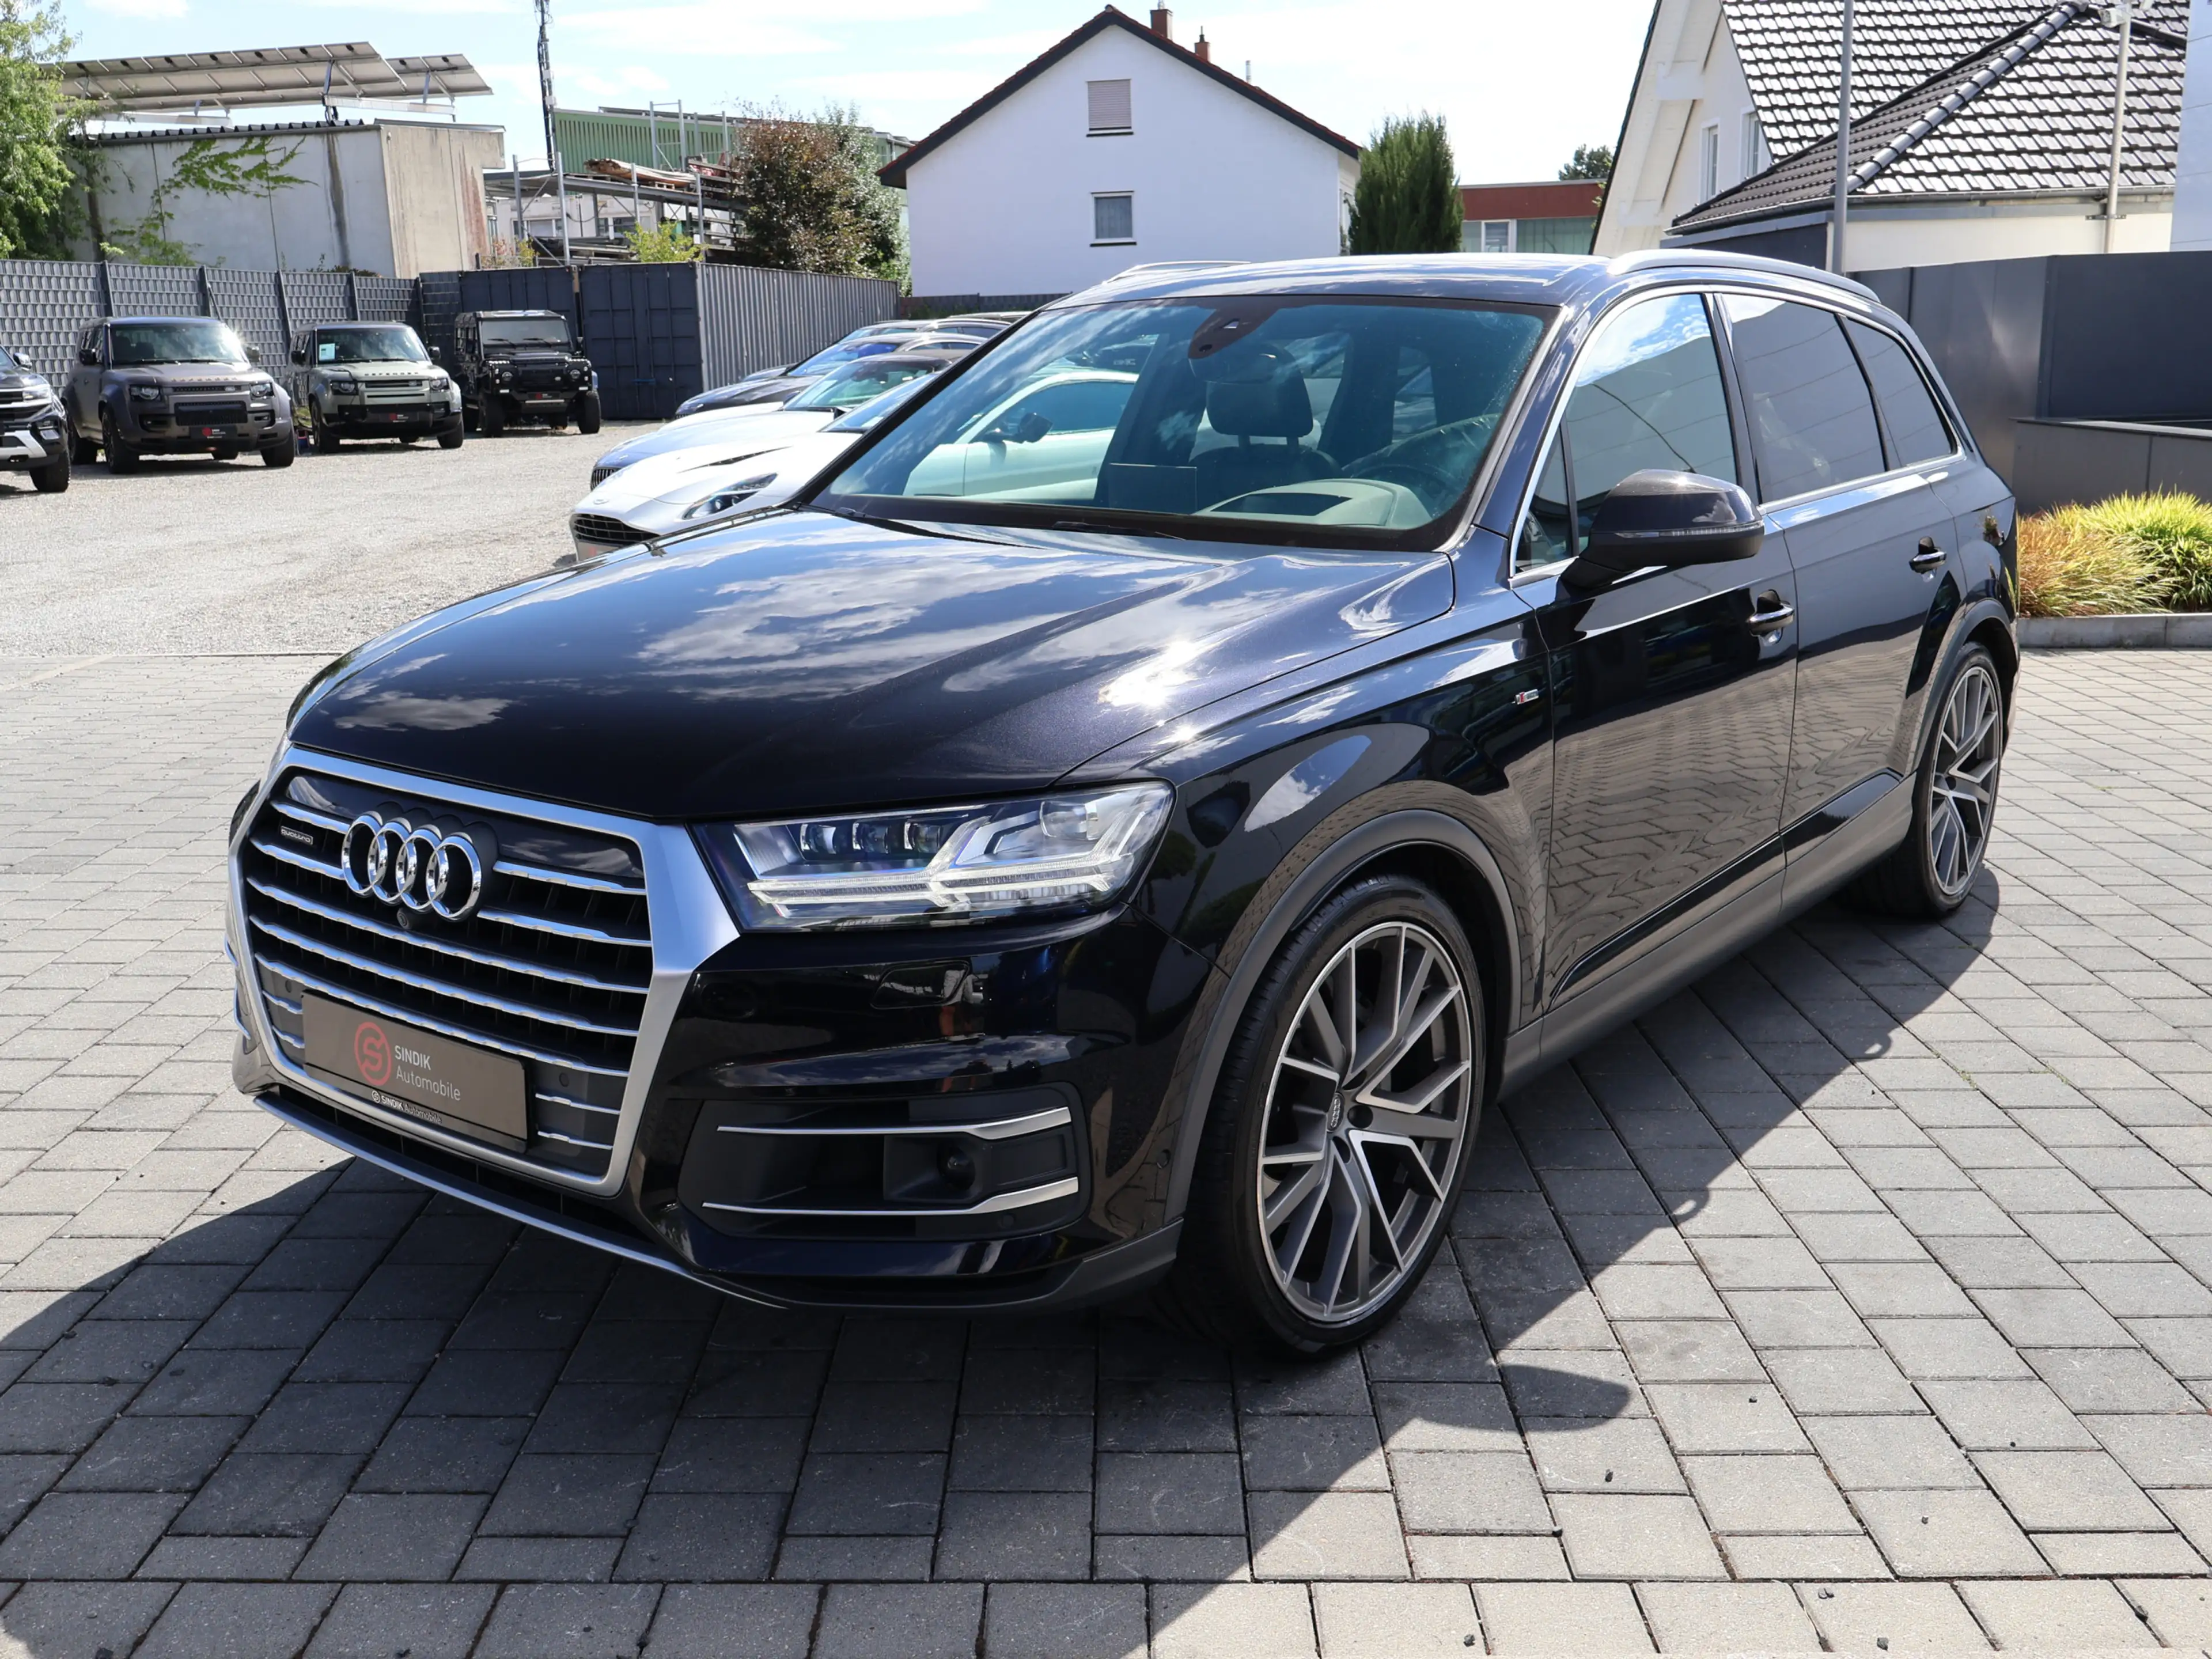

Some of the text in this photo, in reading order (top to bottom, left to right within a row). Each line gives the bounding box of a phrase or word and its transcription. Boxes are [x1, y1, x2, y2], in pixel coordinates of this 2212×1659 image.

[281, 828, 310, 843] quattro
[395, 1046, 431, 1070] SINDIK
[396, 1066, 461, 1101] Automobile
[381, 1096, 403, 1111] SINDIK
[405, 1104, 442, 1124] Automobile
